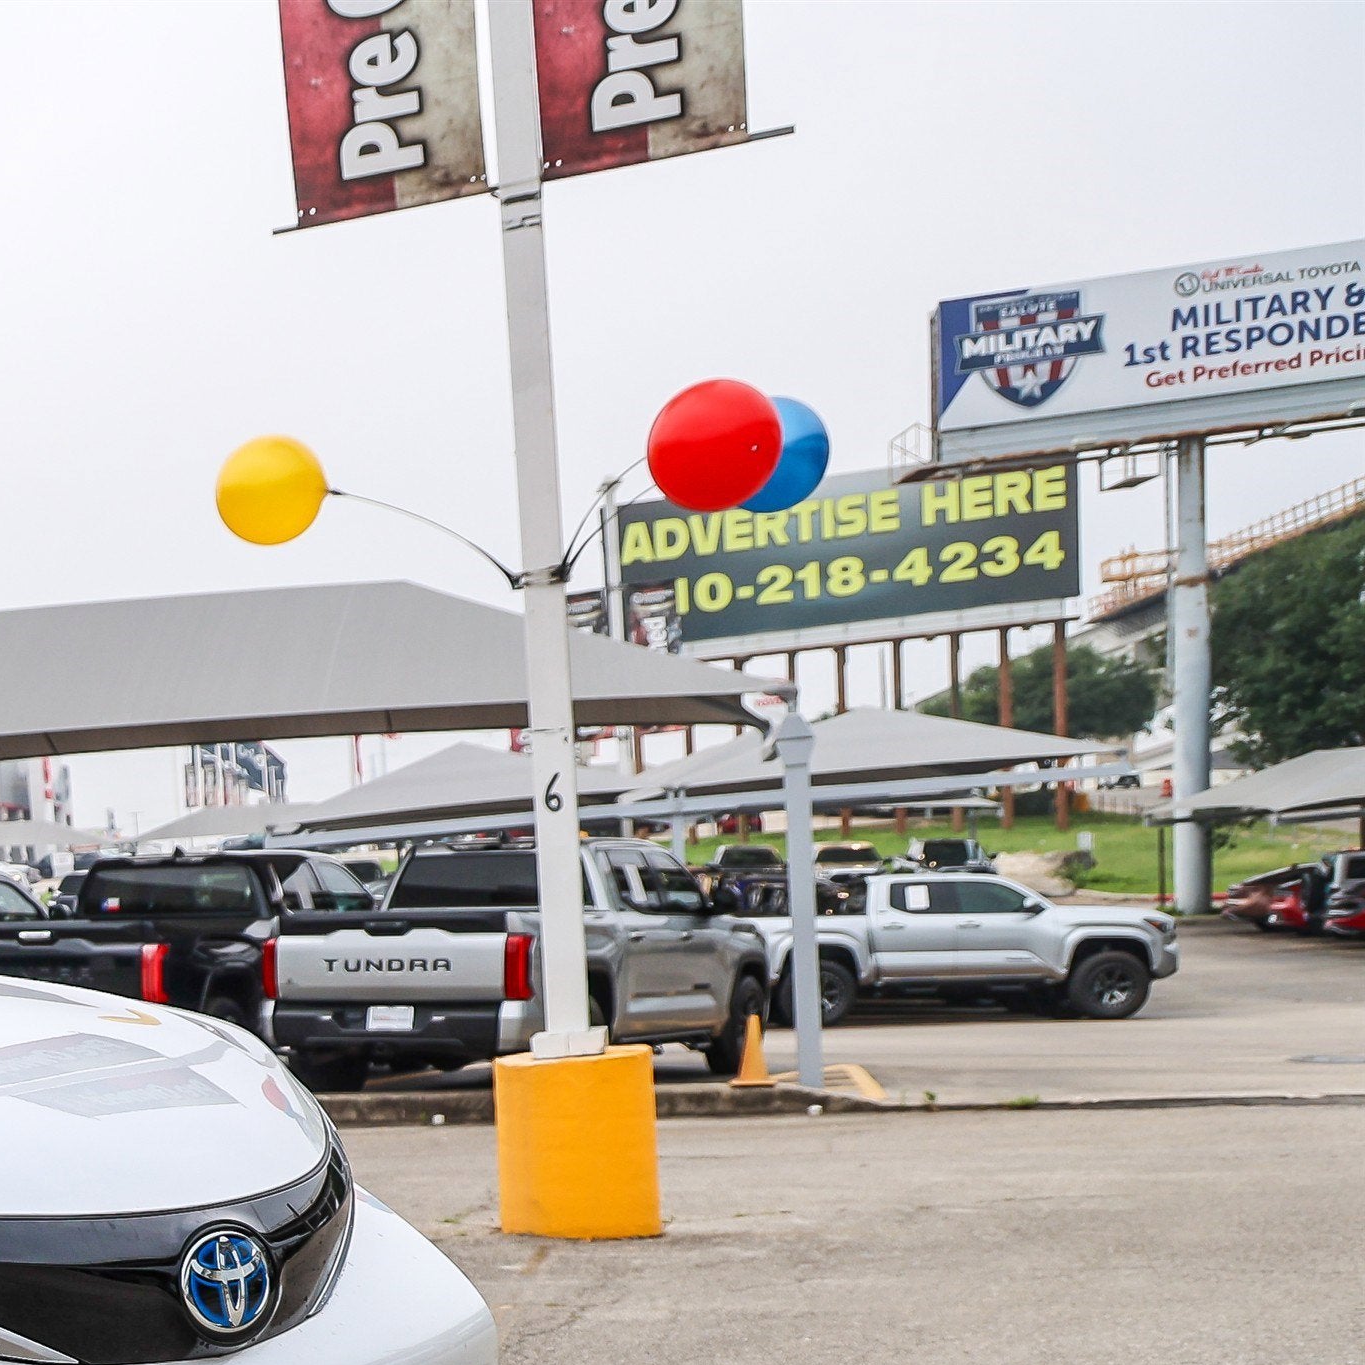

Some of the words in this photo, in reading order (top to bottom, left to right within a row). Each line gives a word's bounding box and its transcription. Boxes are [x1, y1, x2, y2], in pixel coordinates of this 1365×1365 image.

[340, 31, 425, 181] Pre
[1201, 271, 1295, 293] UNIVERSAL
[1298, 260, 1362, 280] TOYOTA
[1171, 285, 1335, 332] MILITARY
[961, 320, 1098, 359] MILITARY
[1124, 340, 1170, 366] 1st
[1146, 370, 1186, 388] Get
[1193, 352, 1302, 382] Preferred
[1310, 344, 1365, 367] Prici
[620, 489, 901, 567] ADVERTISE
[921, 465, 1068, 527] HERE
[545, 772, 563, 811] 6
[323, 958, 452, 973] TUNDRA
